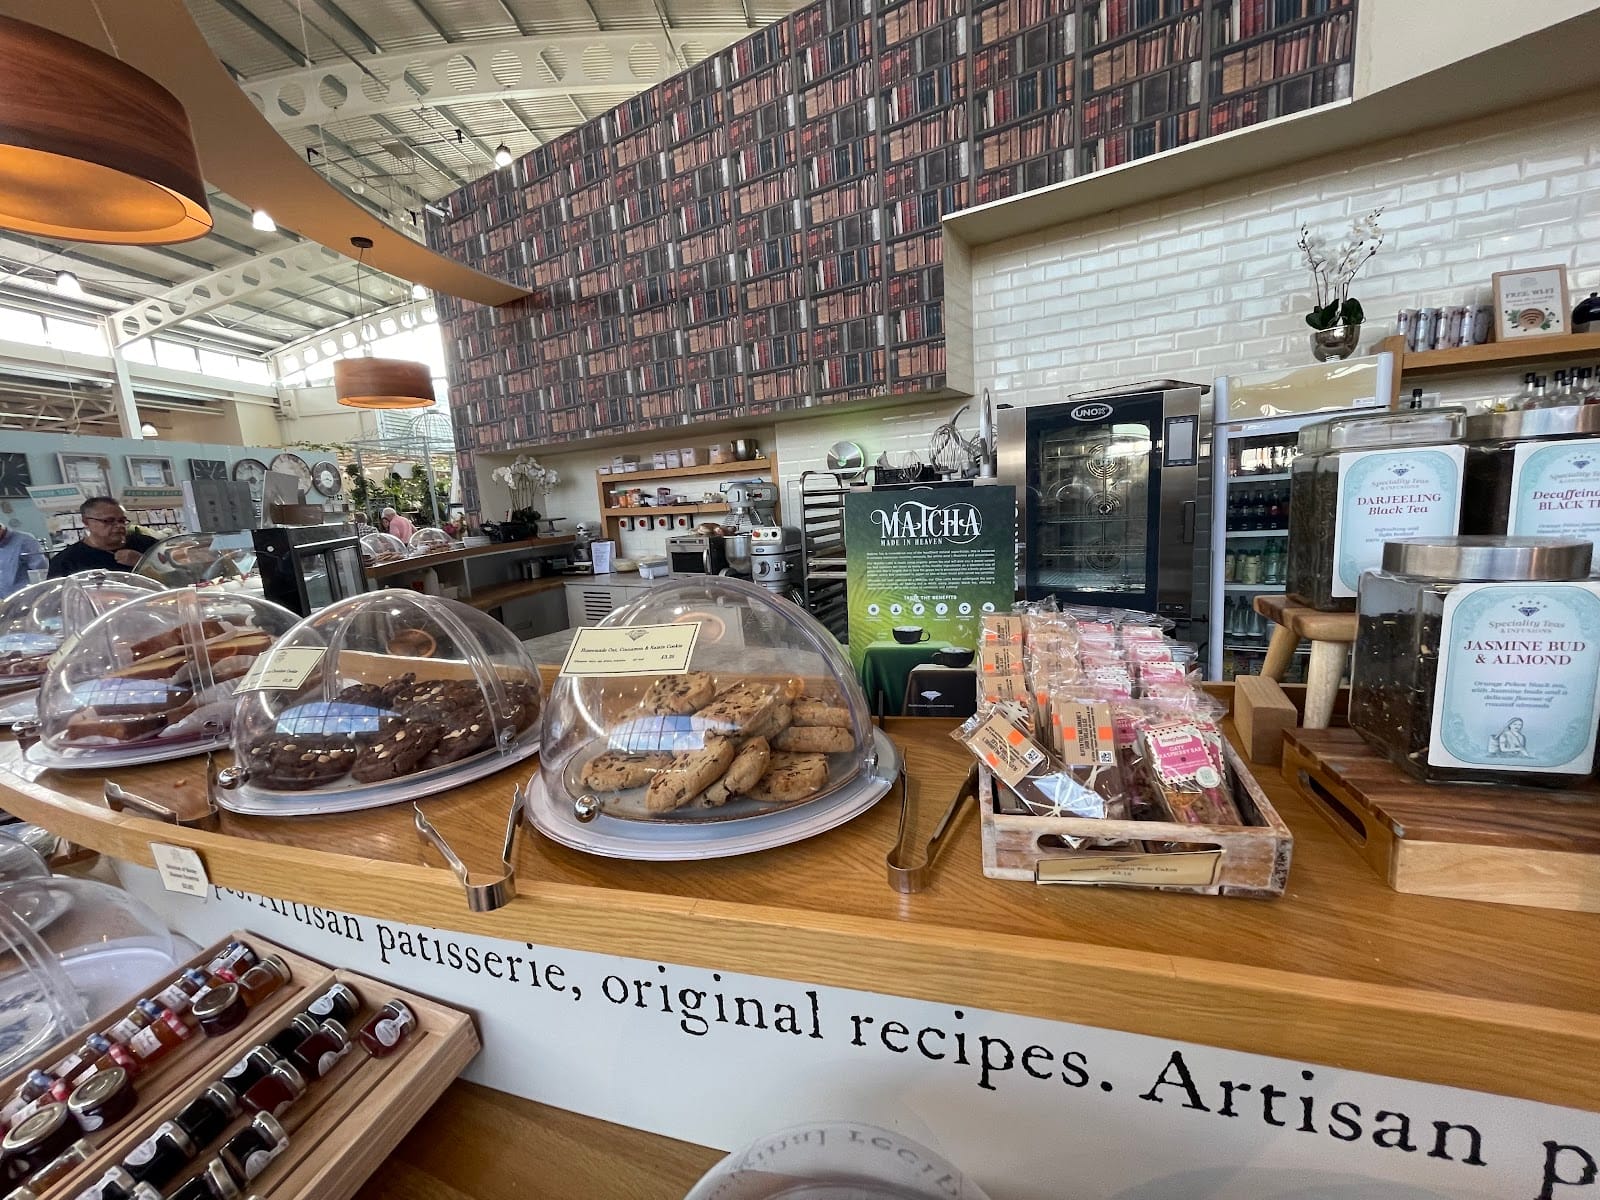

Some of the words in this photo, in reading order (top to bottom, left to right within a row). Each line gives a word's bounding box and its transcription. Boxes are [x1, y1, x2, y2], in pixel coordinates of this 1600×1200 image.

[1357, 493, 1441, 506] DARJEELING
[1368, 506, 1402, 515] Black
[1406, 505, 1428, 513] Tea
[1539, 501, 1584, 510] BLACK
[871, 501, 982, 541] MATCHA
[1488, 619, 1540, 629] Speciality
[1543, 620, 1566, 628] Teas
[1463, 640, 1543, 652] JASMINE
[1548, 642, 1586, 652] BUD
[1475, 654, 1486, 664] &
[1493, 654, 1572, 665] ALMOND
[377, 921, 582, 1001] patisserie,
[602, 966, 823, 1039] original
[850, 1010, 1113, 1090] recipes.
[1139, 1050, 1488, 1166] Artisan
